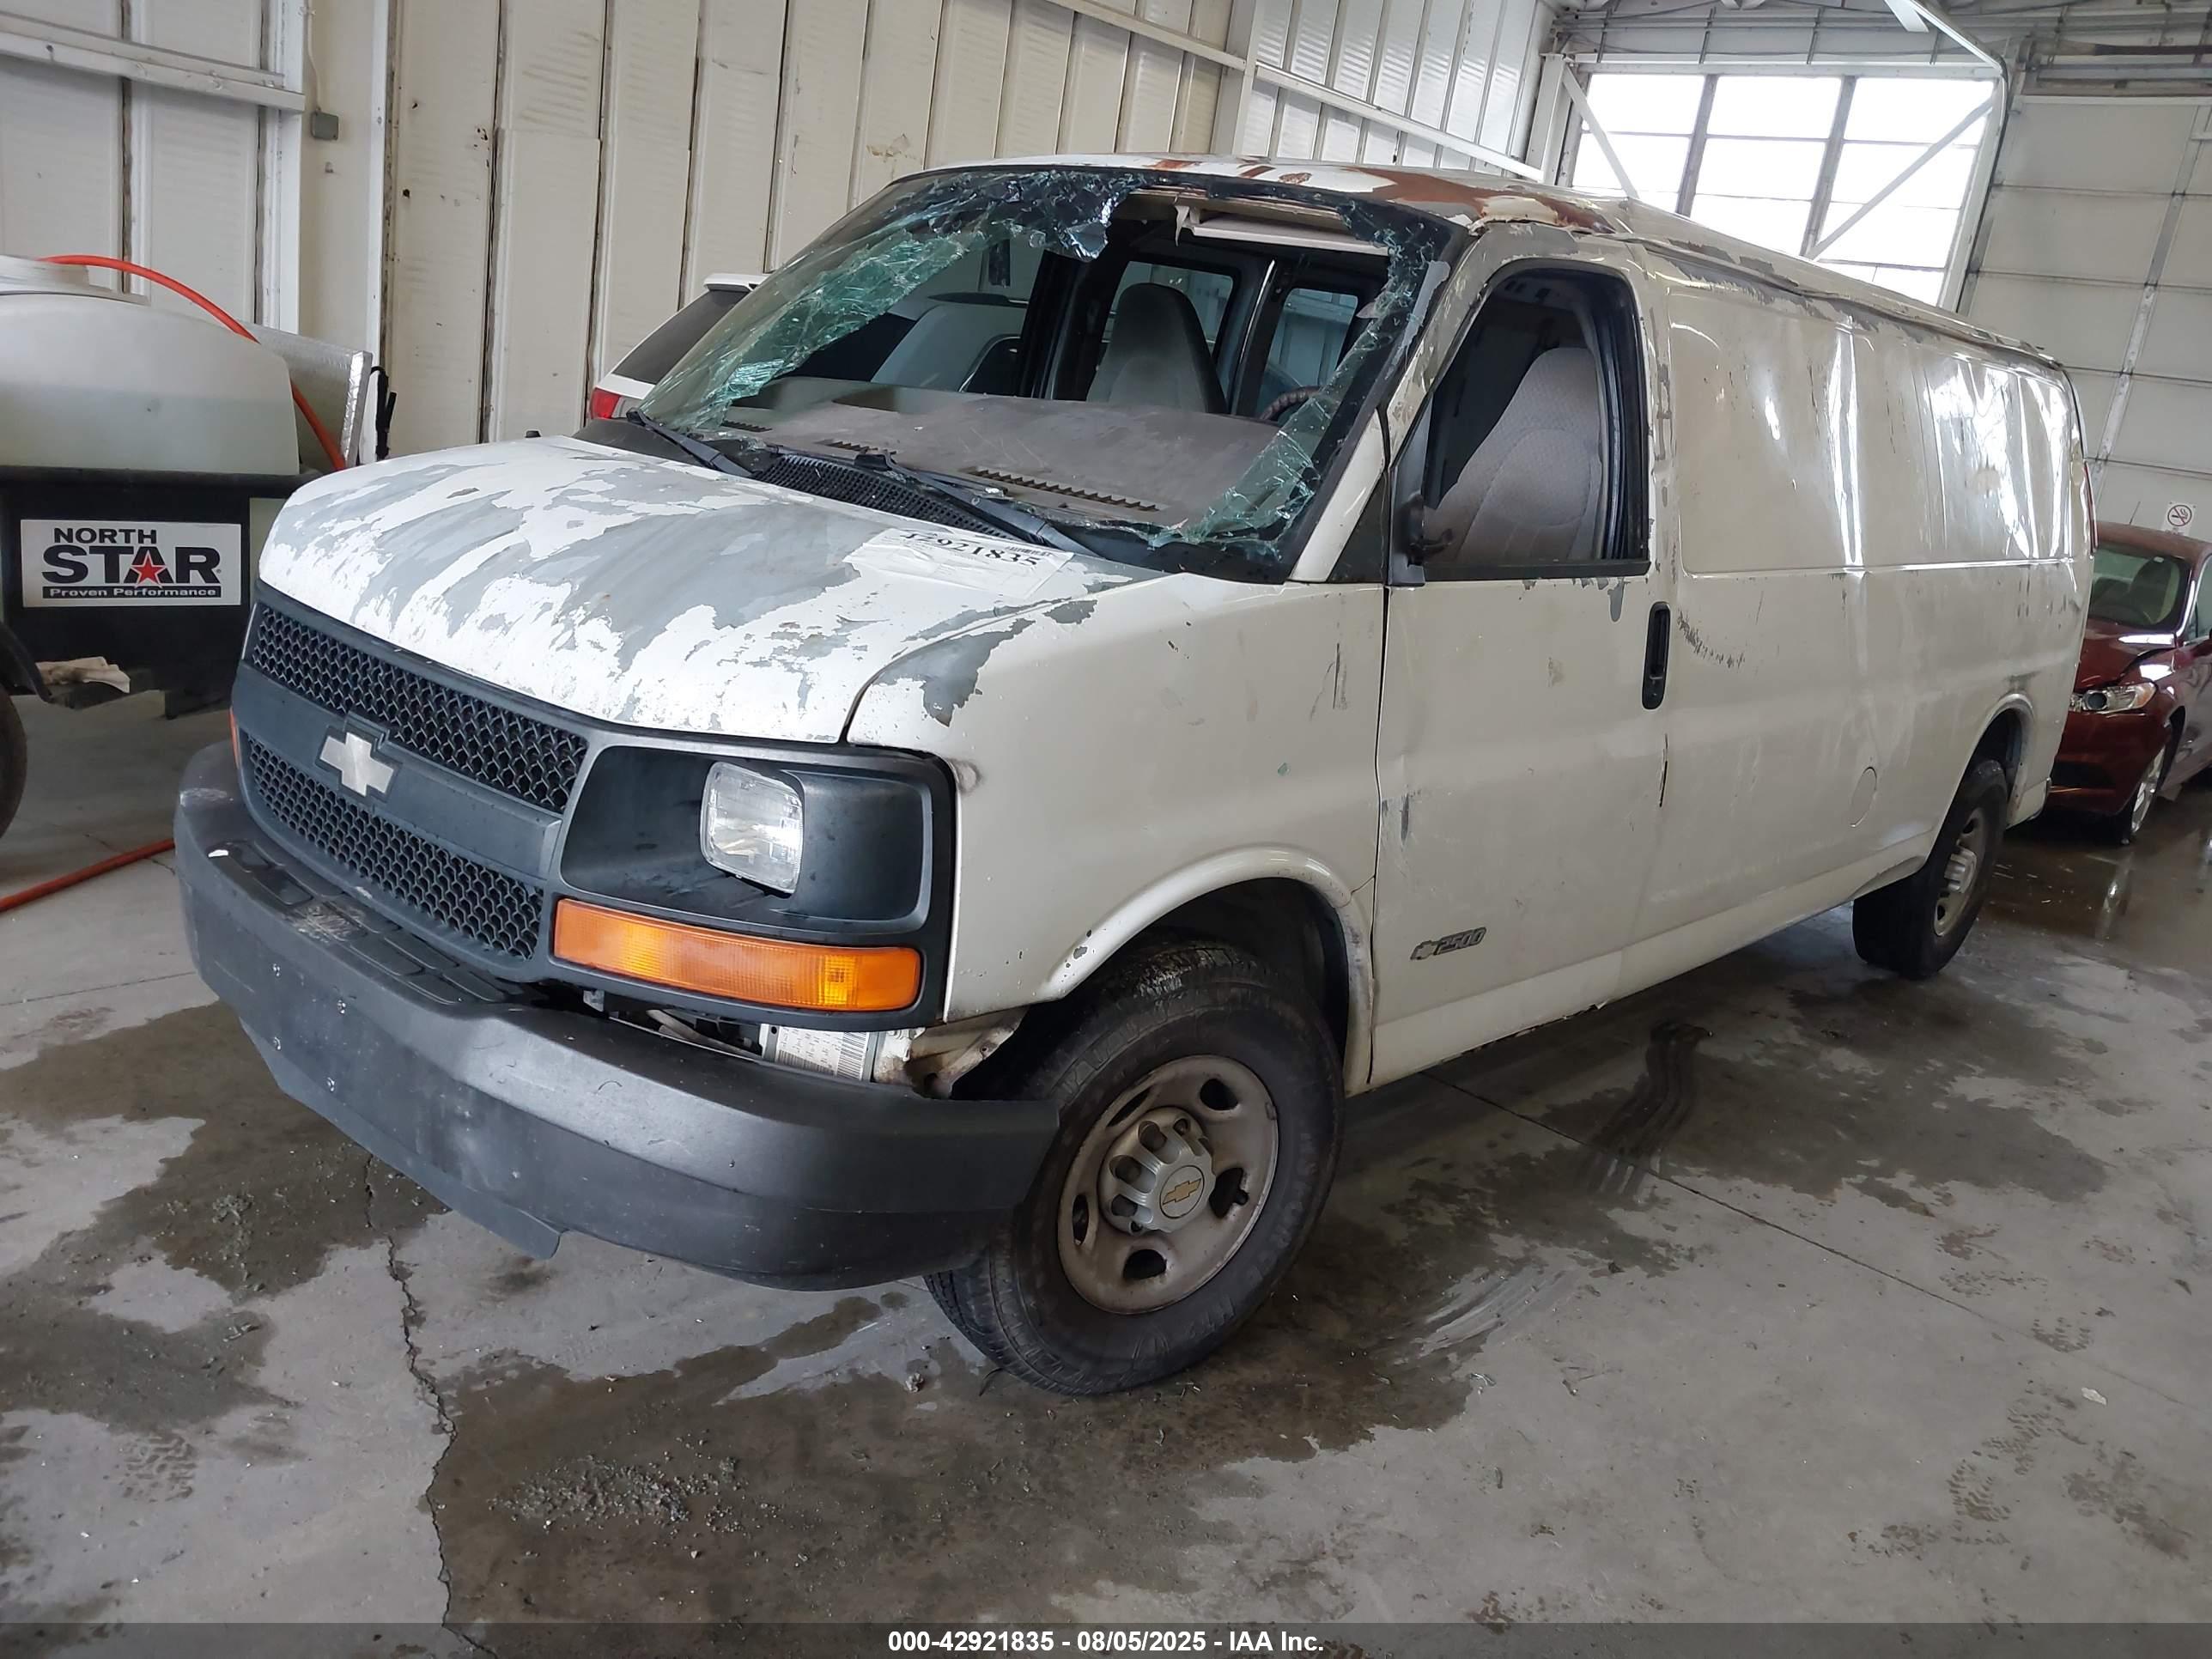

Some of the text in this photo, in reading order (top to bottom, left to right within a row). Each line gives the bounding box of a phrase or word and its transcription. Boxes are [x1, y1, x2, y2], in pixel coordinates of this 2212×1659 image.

[54, 527, 156, 544] NORTH
[41, 544, 222, 584] STAR
[49, 587, 216, 599] Proven Performance
[1437, 927, 1487, 955] 2500
